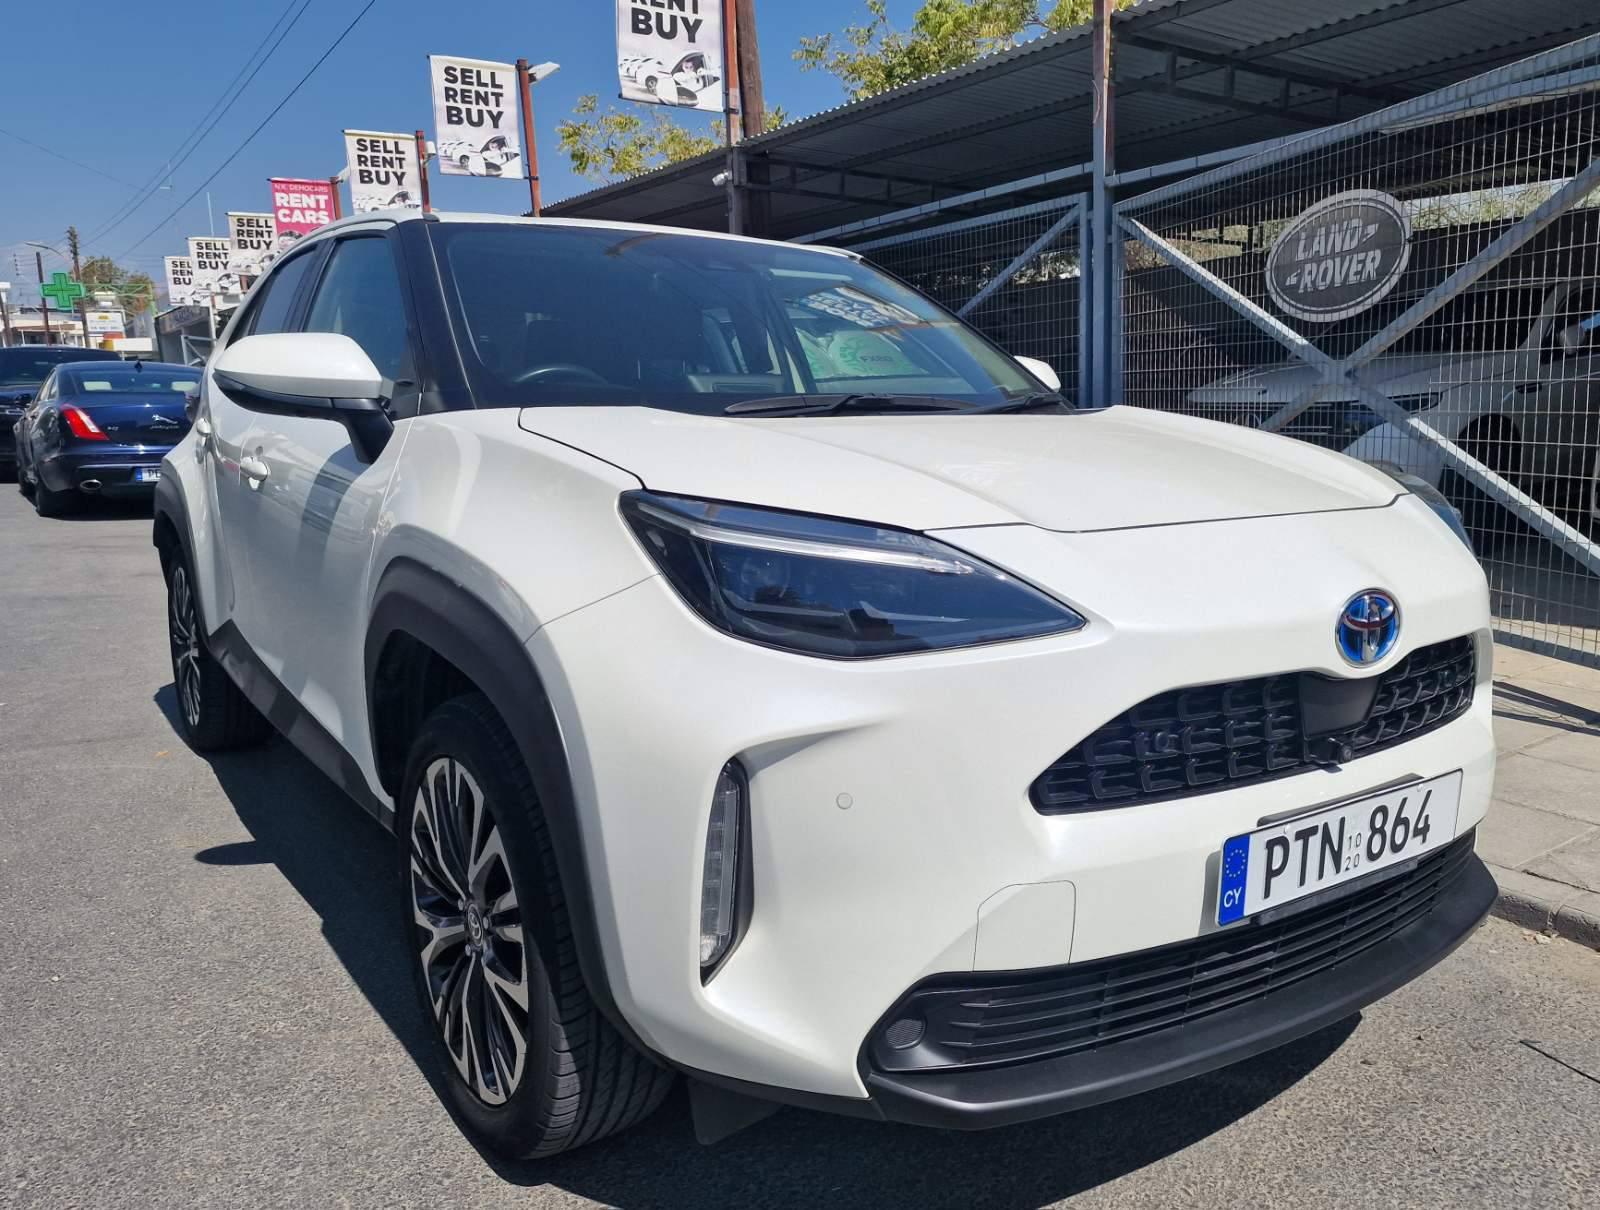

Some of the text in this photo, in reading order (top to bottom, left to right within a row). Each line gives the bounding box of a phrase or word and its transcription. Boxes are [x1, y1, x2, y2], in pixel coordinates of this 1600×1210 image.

[631, 7, 703, 43] BUY
[444, 65, 504, 89] SELL
[444, 86, 504, 108] RENT
[446, 105, 504, 129] BUY
[356, 138, 406, 155] SELL
[357, 154, 406, 170] RENT
[359, 169, 407, 186] BUY
[275, 192, 329, 209] RENT
[236, 218, 273, 229] SELL
[277, 208, 330, 225] CARS
[236, 229, 273, 239] RENT
[1296, 218, 1363, 261] LAND
[196, 242, 229, 251] SELL
[237, 239, 273, 250] BUY
[196, 251, 230, 260] RENT
[172, 260, 192, 269] SEL
[172, 269, 193, 277] REN
[198, 260, 230, 270] BUY
[1298, 249, 1382, 293] ROVER
[173, 277, 192, 286] BU
[1264, 789, 1433, 899] PTN 864
[1348, 832, 1362, 849] 10
[1345, 853, 1360, 871] 20
[1223, 886, 1242, 908] CY
